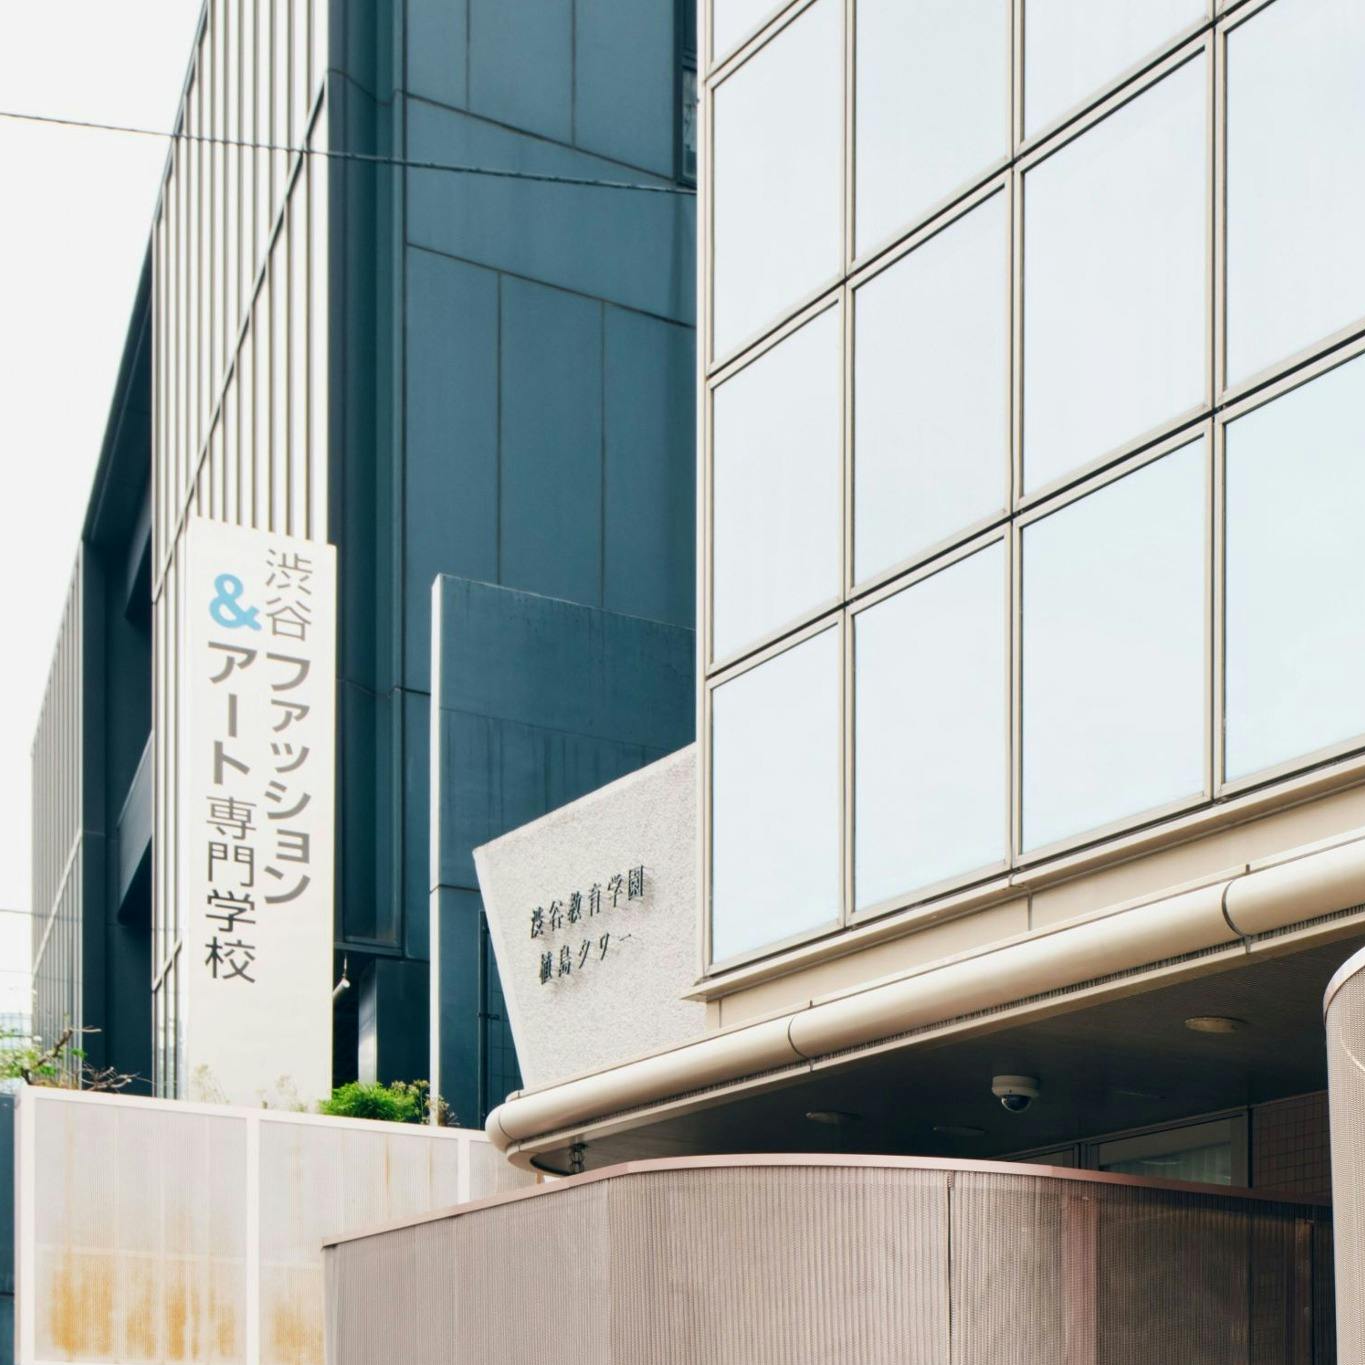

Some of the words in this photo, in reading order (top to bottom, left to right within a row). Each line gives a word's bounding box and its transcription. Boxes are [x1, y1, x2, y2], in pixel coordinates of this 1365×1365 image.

[205, 572, 262, 983] &アート専門学校
[264, 548, 314, 905] 渋谷ファッション
